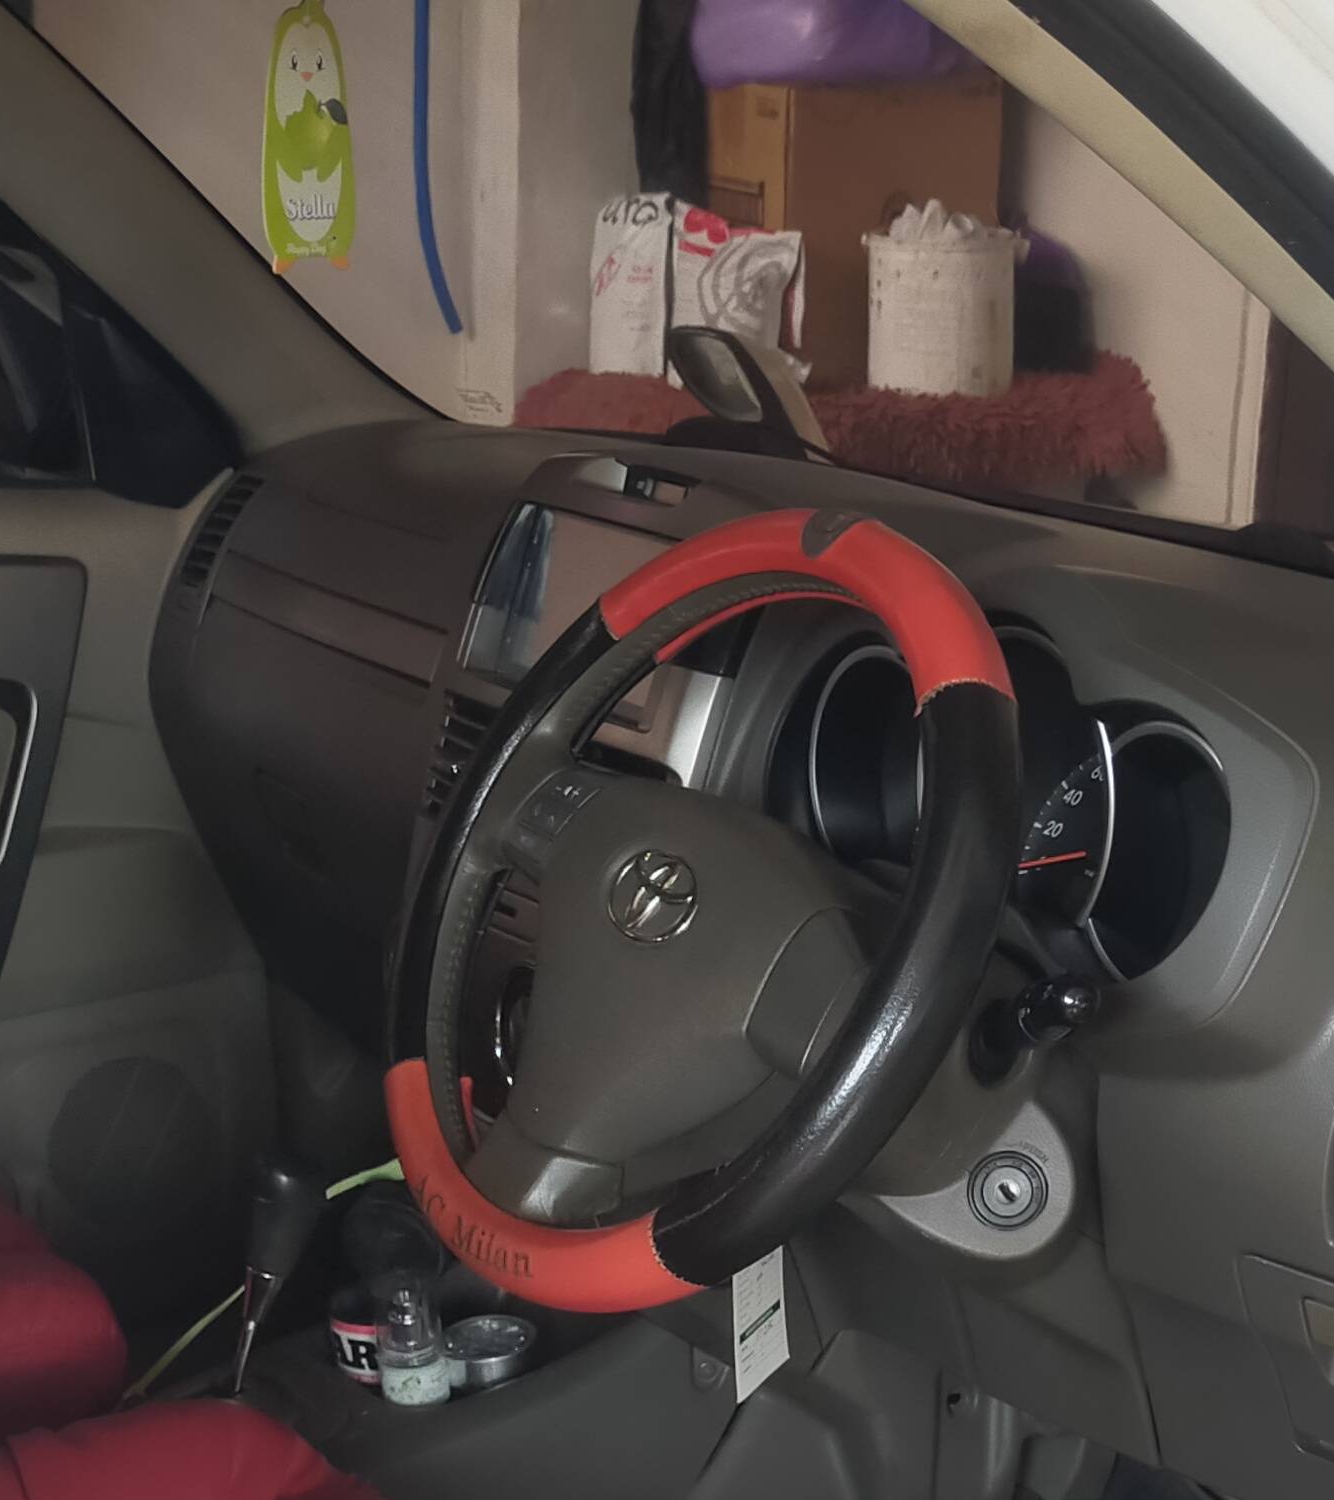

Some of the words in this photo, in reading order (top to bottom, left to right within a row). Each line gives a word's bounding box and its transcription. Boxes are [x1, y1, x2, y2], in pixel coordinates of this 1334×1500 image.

[285, 193, 336, 221] Stella
[1063, 788, 1083, 806] 40
[1043, 820, 1064, 838] 20
[452, 1214, 534, 1280] Milan
